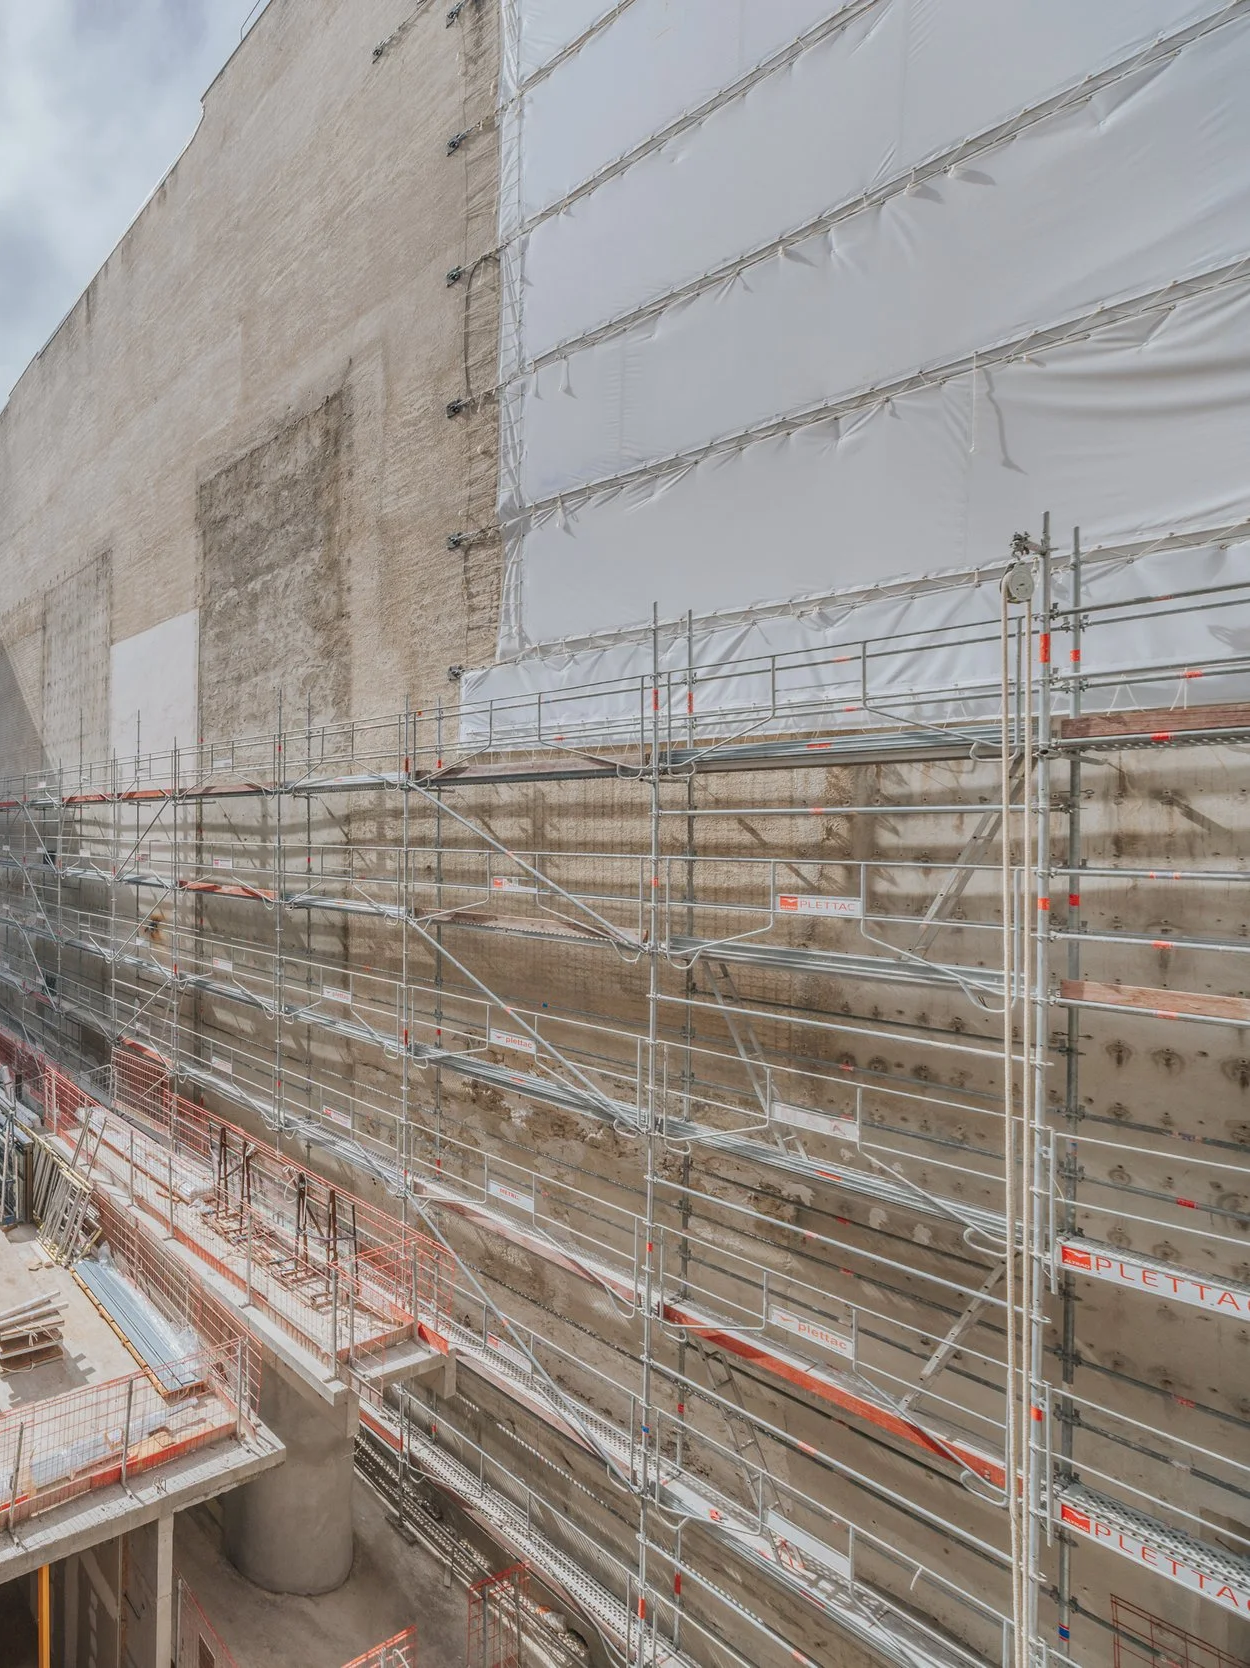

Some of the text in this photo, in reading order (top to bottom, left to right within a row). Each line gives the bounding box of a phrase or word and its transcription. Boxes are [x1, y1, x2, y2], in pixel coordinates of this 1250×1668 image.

[800, 900, 855, 911] PLETTAC
[505, 1036, 533, 1048] plettac
[1063, 1259, 1091, 1269] ALTRAD
[1095, 1256, 1250, 1312] PLETTA
[797, 1322, 847, 1350] plettac
[1095, 1522, 1250, 1611] PLETTA
